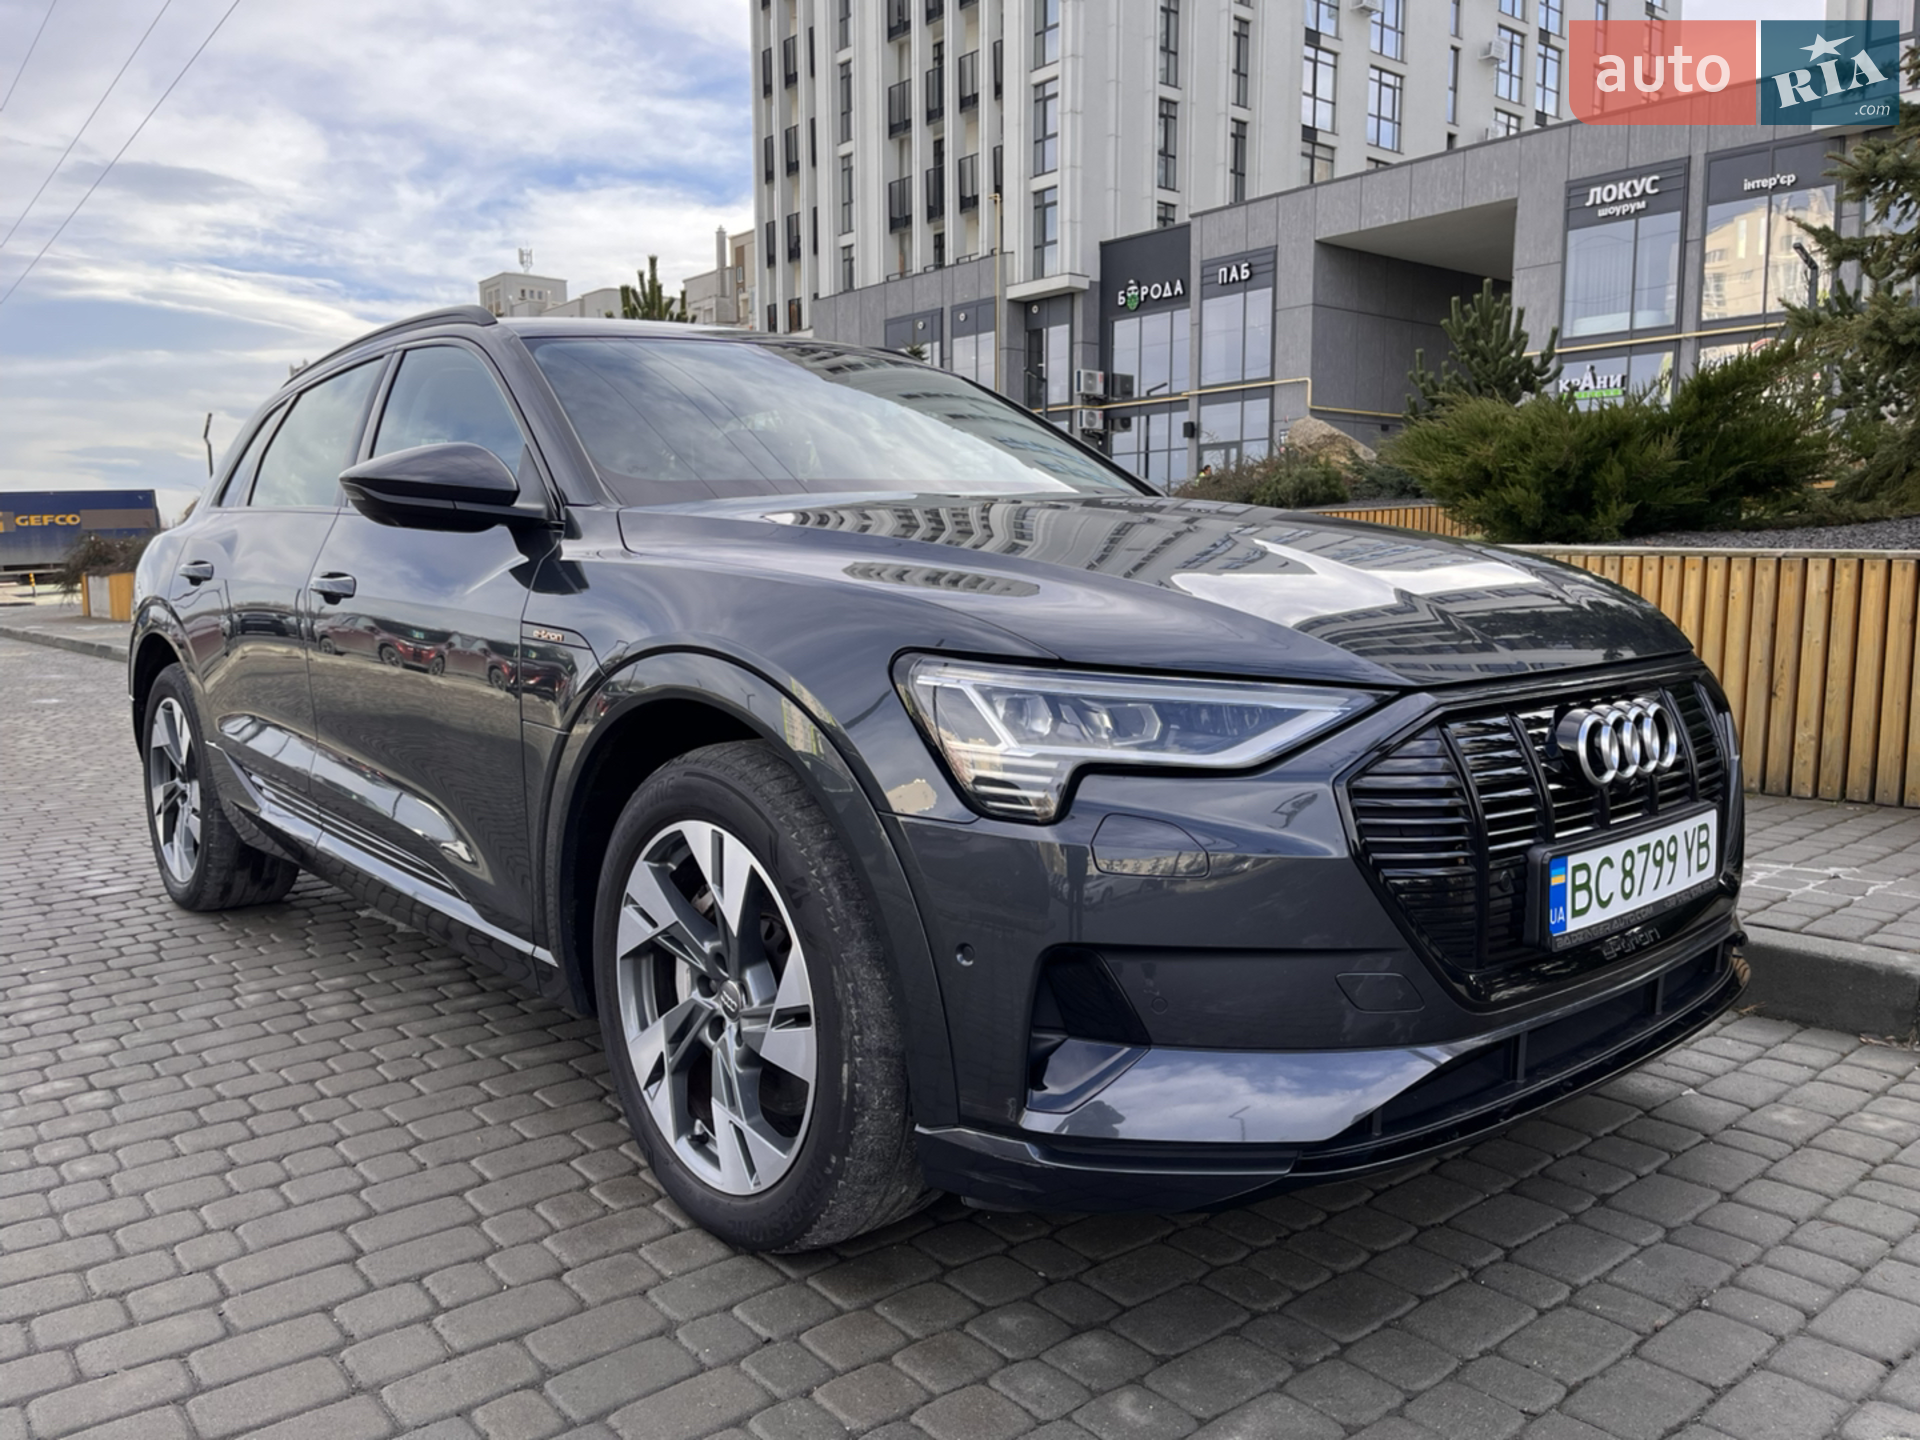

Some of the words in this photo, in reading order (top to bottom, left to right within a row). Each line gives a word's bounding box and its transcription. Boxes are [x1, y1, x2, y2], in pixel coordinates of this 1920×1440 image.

[1585, 175, 1660, 206] ЛОКУС
[1598, 199, 1646, 218] шоурум
[1218, 262, 1251, 285] ПАБ
[15, 514, 81, 526] GEFCO
[1571, 856, 1615, 918] BC
[1621, 834, 1678, 901] 8799
[1684, 822, 1710, 877] YB
[1550, 907, 1565, 925] UA
